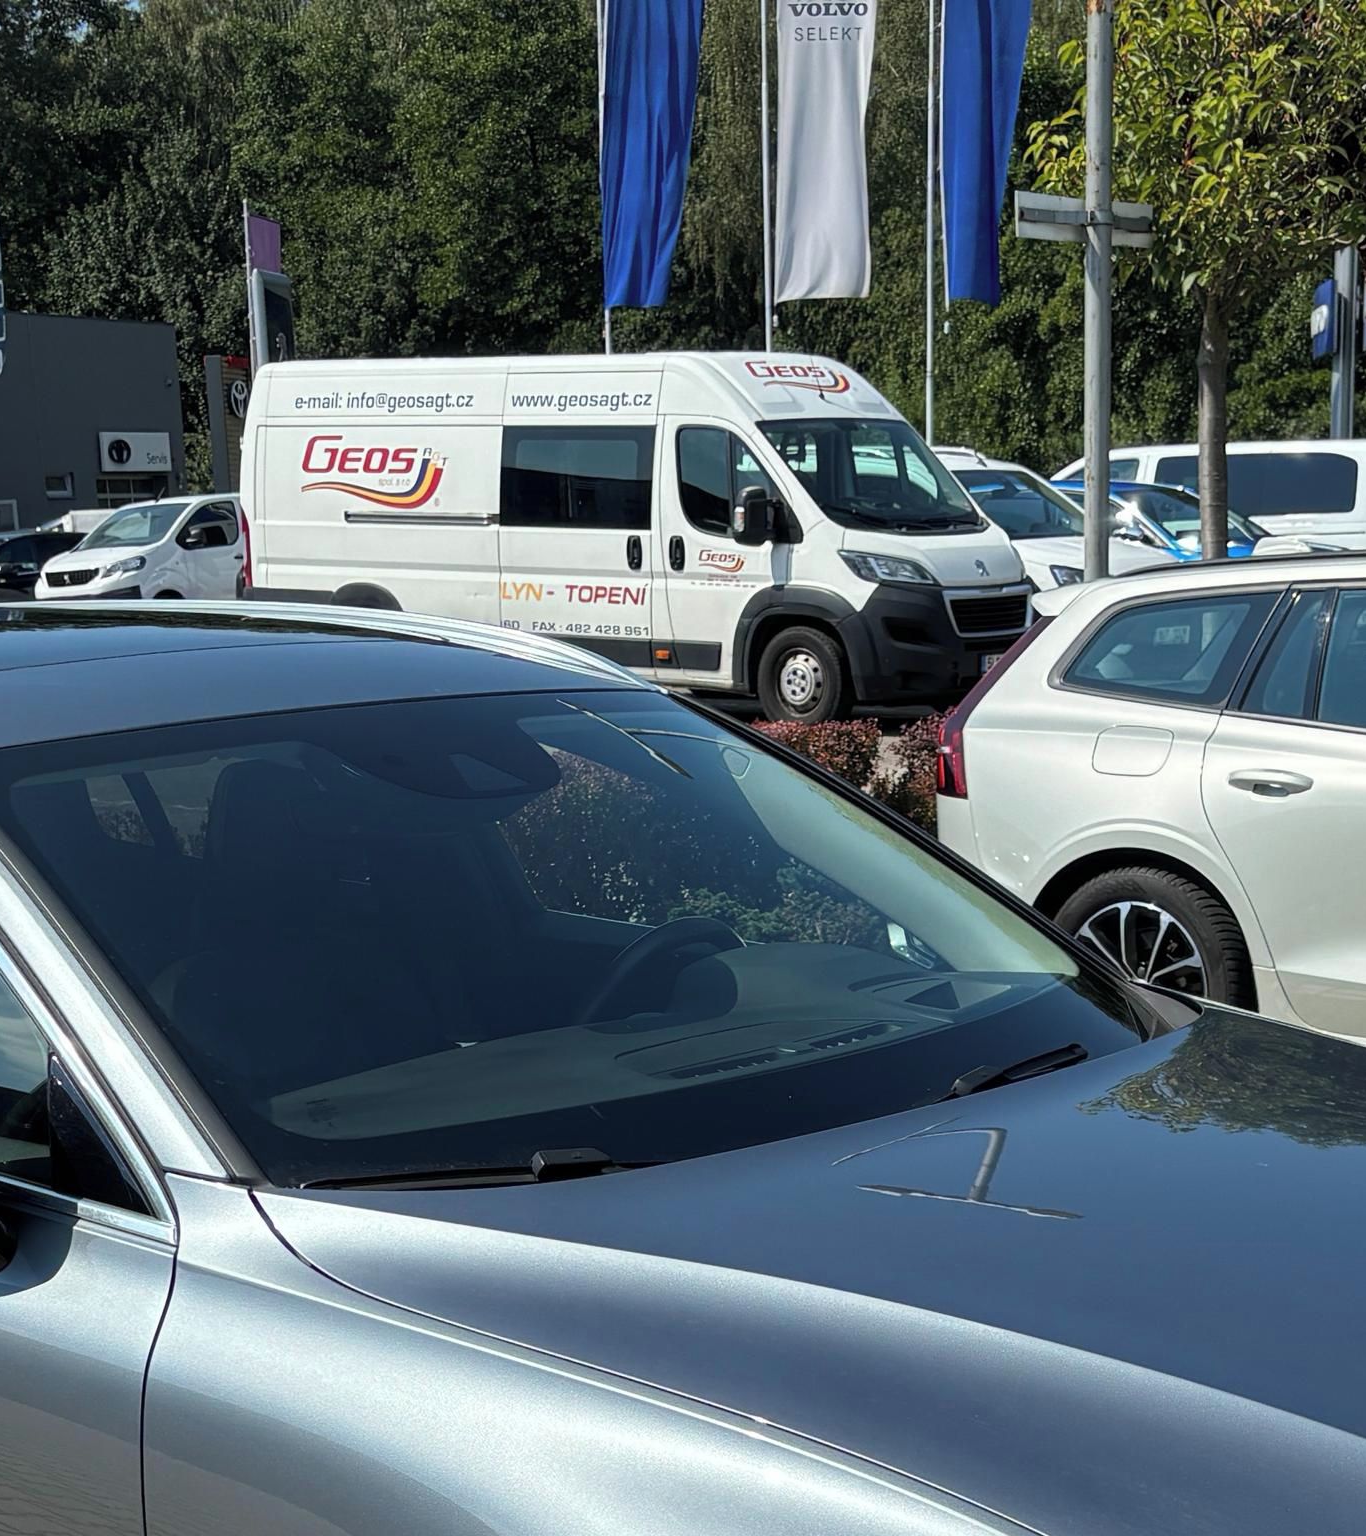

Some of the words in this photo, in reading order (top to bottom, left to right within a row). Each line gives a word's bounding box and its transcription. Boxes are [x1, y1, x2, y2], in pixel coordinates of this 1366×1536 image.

[787, 3, 868, 17] VOLVO
[794, 27, 862, 41] SELEKT
[745, 361, 826, 378] GEOS
[295, 392, 343, 409] e-mail:
[346, 392, 475, 413] info@geosagt.cz
[511, 391, 653, 412] www.geosagt.cz
[302, 435, 419, 474] GEOS
[698, 549, 736, 562] GEOS
[565, 583, 649, 606] TOPENÍ
[532, 621, 556, 632] FAX
[565, 623, 591, 634] 482
[595, 625, 621, 635] 428
[624, 627, 650, 637] 961
